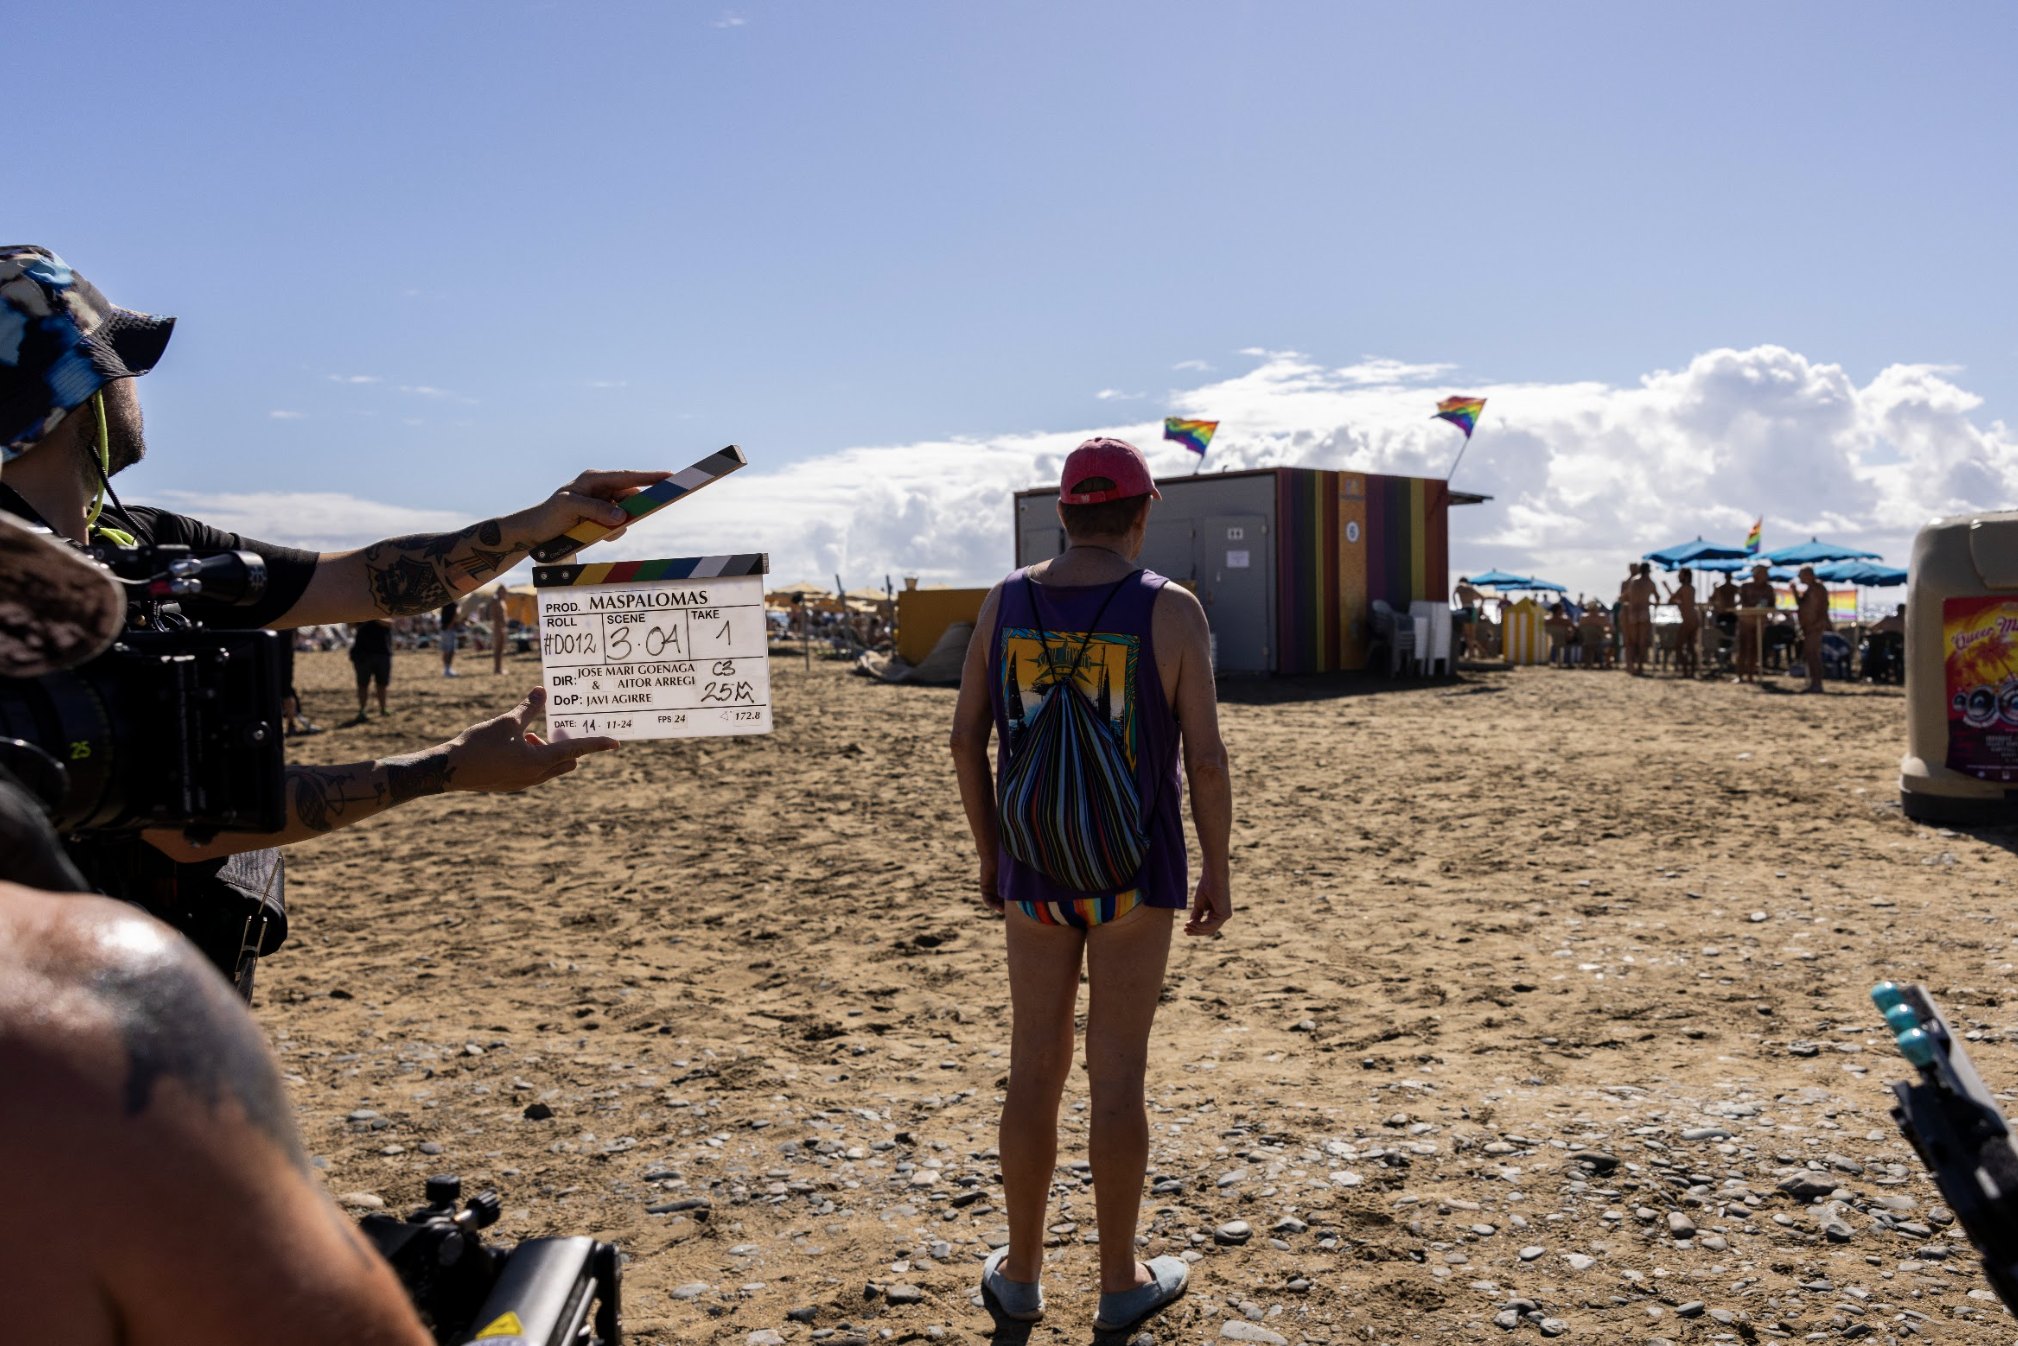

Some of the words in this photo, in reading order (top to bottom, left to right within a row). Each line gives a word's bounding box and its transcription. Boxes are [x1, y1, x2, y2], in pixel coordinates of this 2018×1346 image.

[546, 602, 581, 613] PROD.
[589, 590, 708, 610] MASPALOMAS
[607, 613, 646, 625] SCENE
[691, 609, 720, 620] TAKE
[547, 617, 577, 628] ROLL
[715, 620, 731, 646] 1
[553, 675, 577, 686] DIR:
[577, 667, 603, 678] JOSE
[605, 665, 634, 676] MARI
[637, 663, 695, 675] GOENAGA
[591, 680, 600, 690] &
[617, 678, 652, 688] AITOR
[654, 676, 695, 687] ARREGI
[554, 694, 583, 706] DoP:
[586, 695, 608, 706] JAVI
[611, 693, 652, 704] AGIRRE
[657, 715, 672, 723] FPS
[674, 714, 686, 723] 24
[735, 711, 761, 721] 172.8
[554, 720, 577, 729] DATE:
[70, 740, 92, 760] 25
